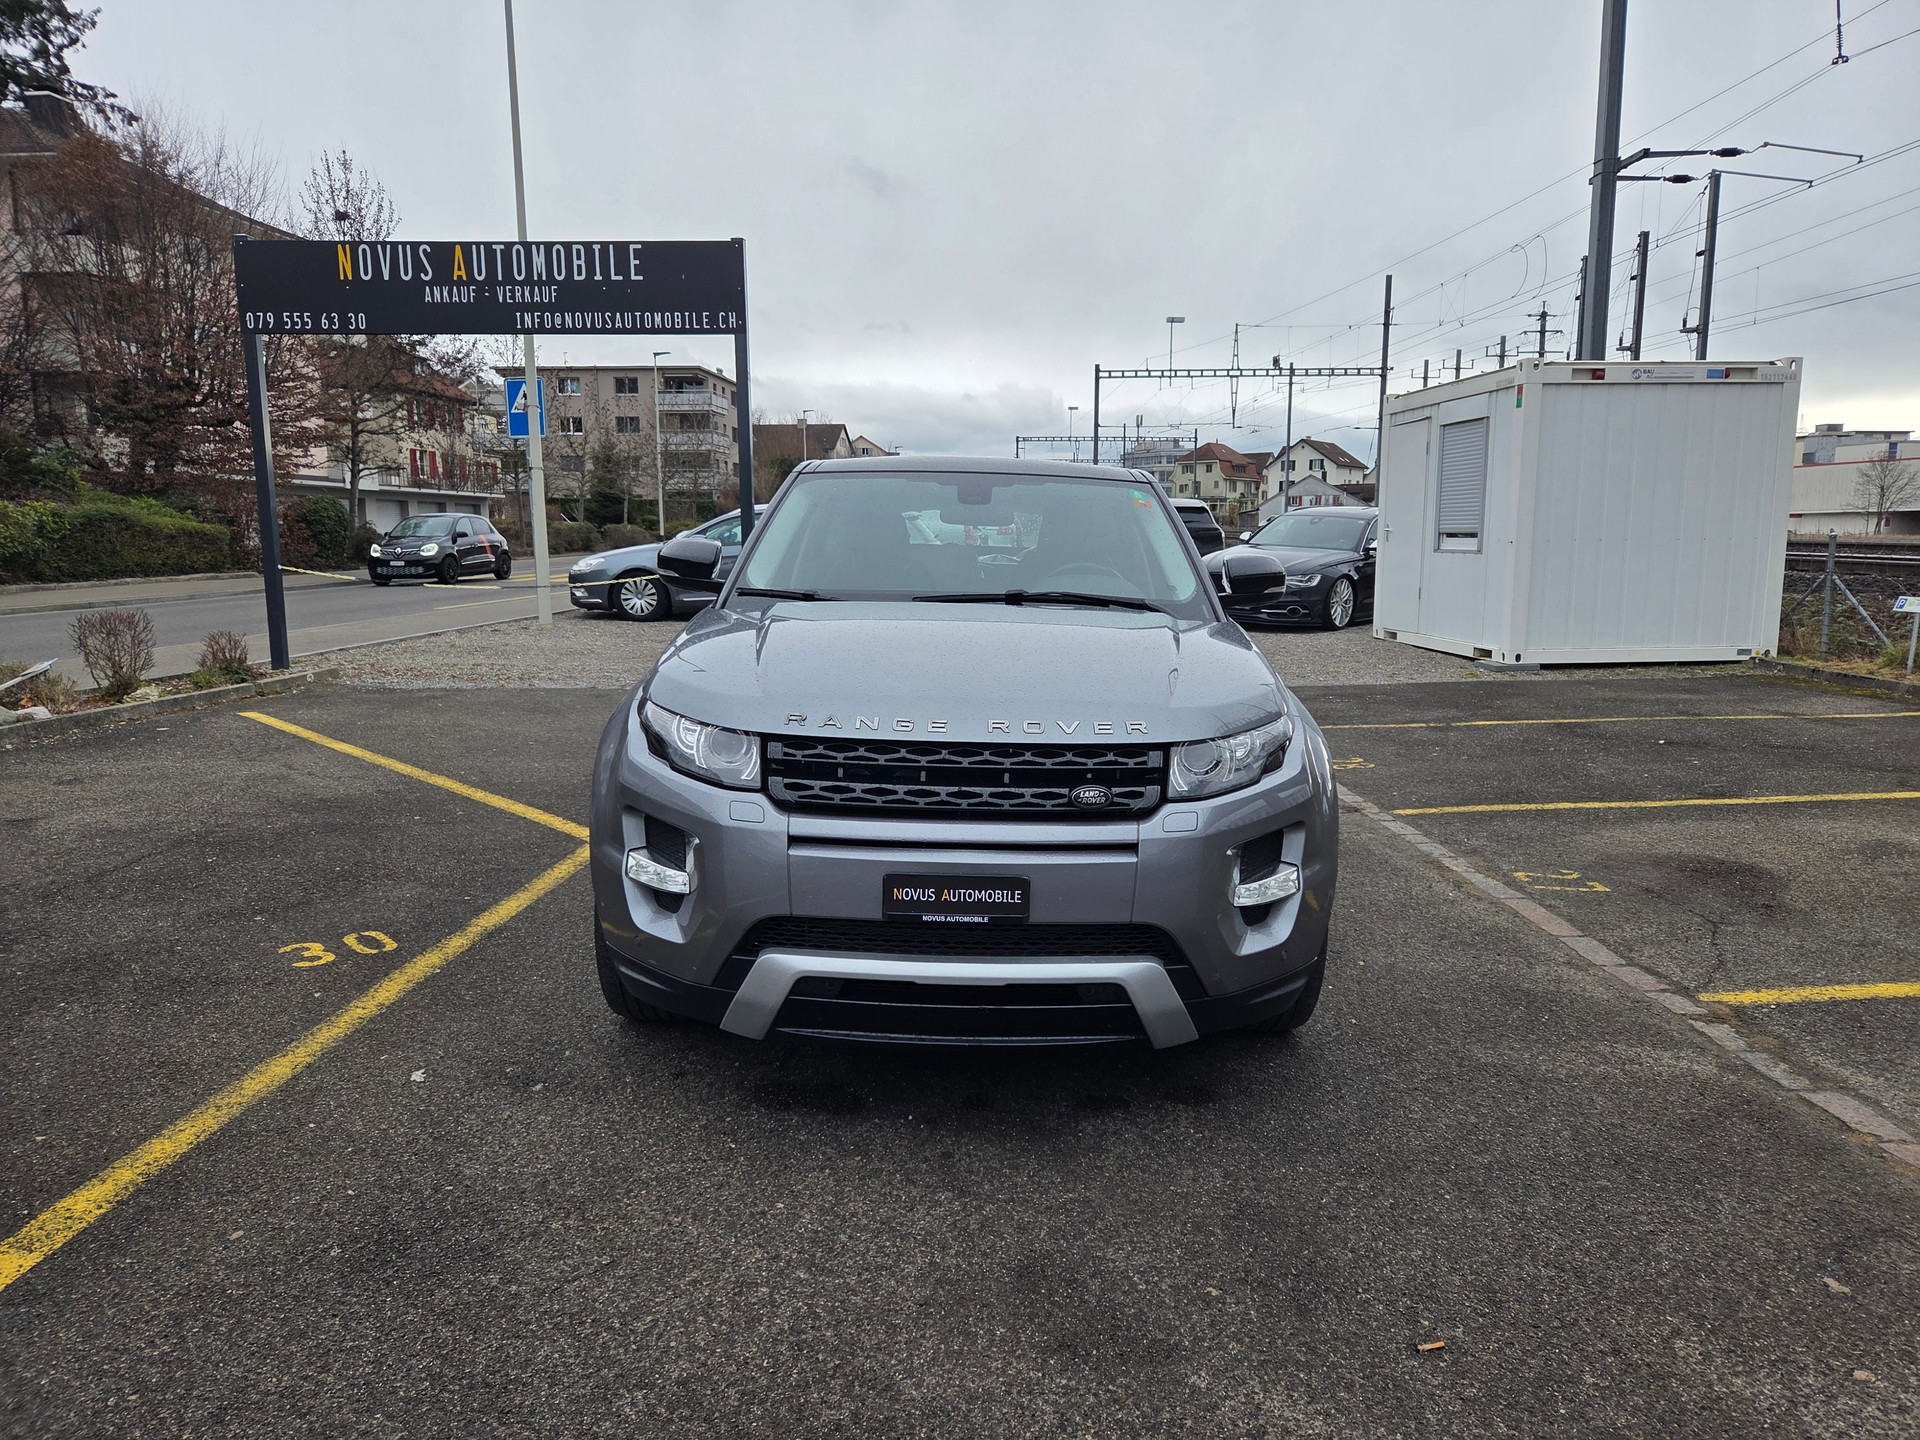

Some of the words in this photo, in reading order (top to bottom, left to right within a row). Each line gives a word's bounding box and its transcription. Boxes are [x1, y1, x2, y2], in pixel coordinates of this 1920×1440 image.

[336, 244, 433, 281] NOVUS
[453, 244, 644, 281] AUTOMOBILE
[424, 285, 477, 303] ANKAUF
[496, 285, 558, 303] VERKAUF
[246, 312, 274, 329] 079
[282, 312, 312, 329] 555
[321, 312, 339, 329] 63
[347, 312, 366, 330] 30
[515, 311, 737, 329] INFO@NOVUSAUTOMOBILE.CH
[784, 712, 948, 733] RANGE
[987, 718, 1150, 735] ROVER
[1080, 790, 1100, 798] LAND
[892, 887, 936, 901] NOVUS
[941, 889, 1022, 903] AUTOMOBILE
[946, 915, 989, 923] AUTOMOBILE
[276, 930, 398, 967] 30
